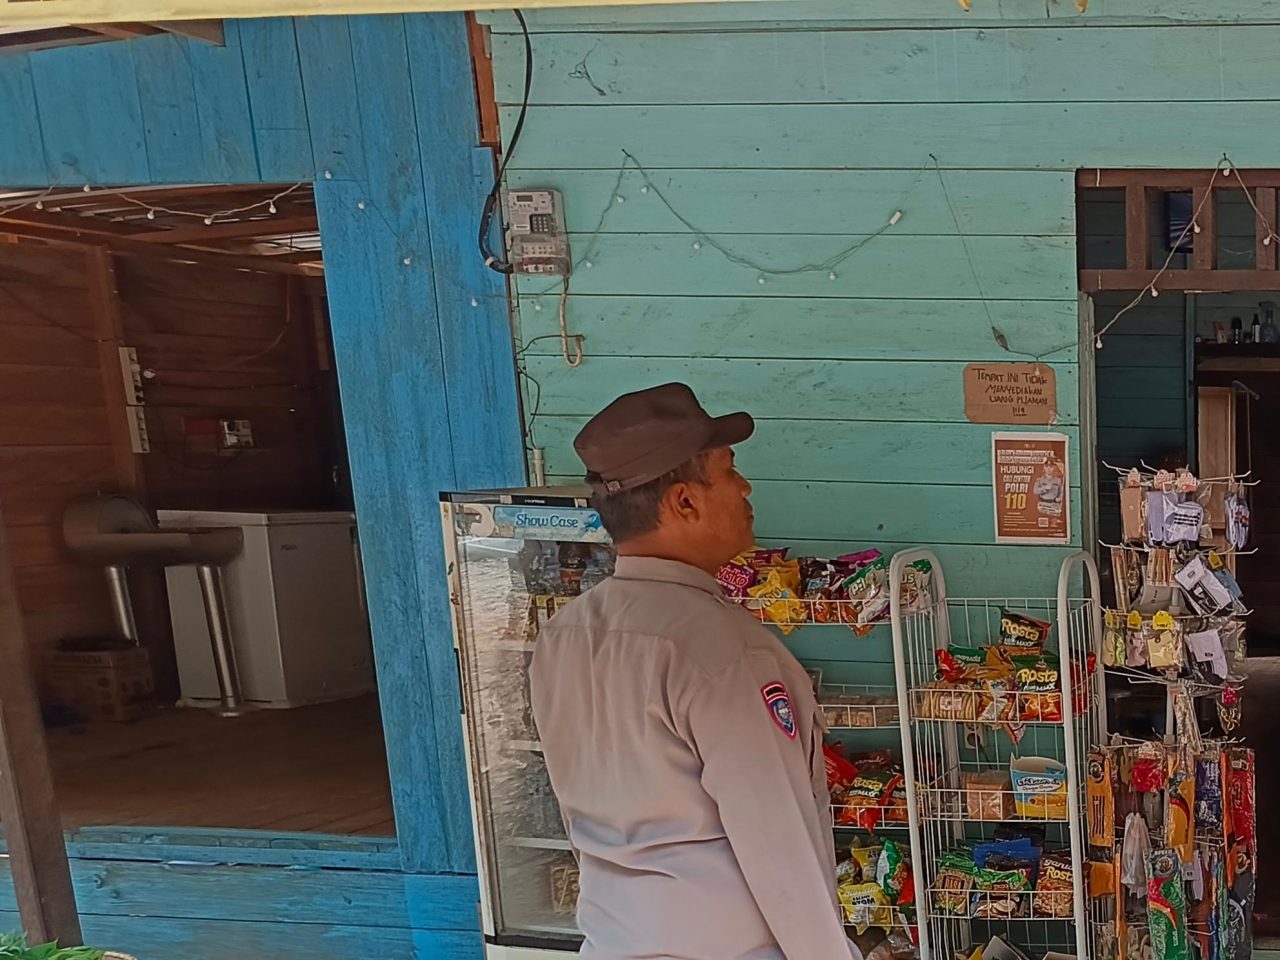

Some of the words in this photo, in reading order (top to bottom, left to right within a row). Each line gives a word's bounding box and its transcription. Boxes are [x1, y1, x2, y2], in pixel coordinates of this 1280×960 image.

[971, 367, 1005, 383] TEMPAT
[1007, 371, 1019, 383] INI
[1021, 372, 1048, 385] TIDAK
[984, 384, 1043, 396] MENYEDIAKAN
[989, 395, 1015, 404] UANG
[1000, 465, 1035, 474] HUBUNGI
[1004, 483, 1029, 493] POLRI
[1004, 492, 1028, 510] 110
[515, 512, 550, 528] Show
[550, 514, 579, 528] Case
[1001, 618, 1040, 641] Rosta
[1019, 667, 1058, 683] Rosta
[850, 776, 883, 792] Rosta
[1043, 859, 1073, 872] garu
[1046, 866, 1073, 881] Rost
